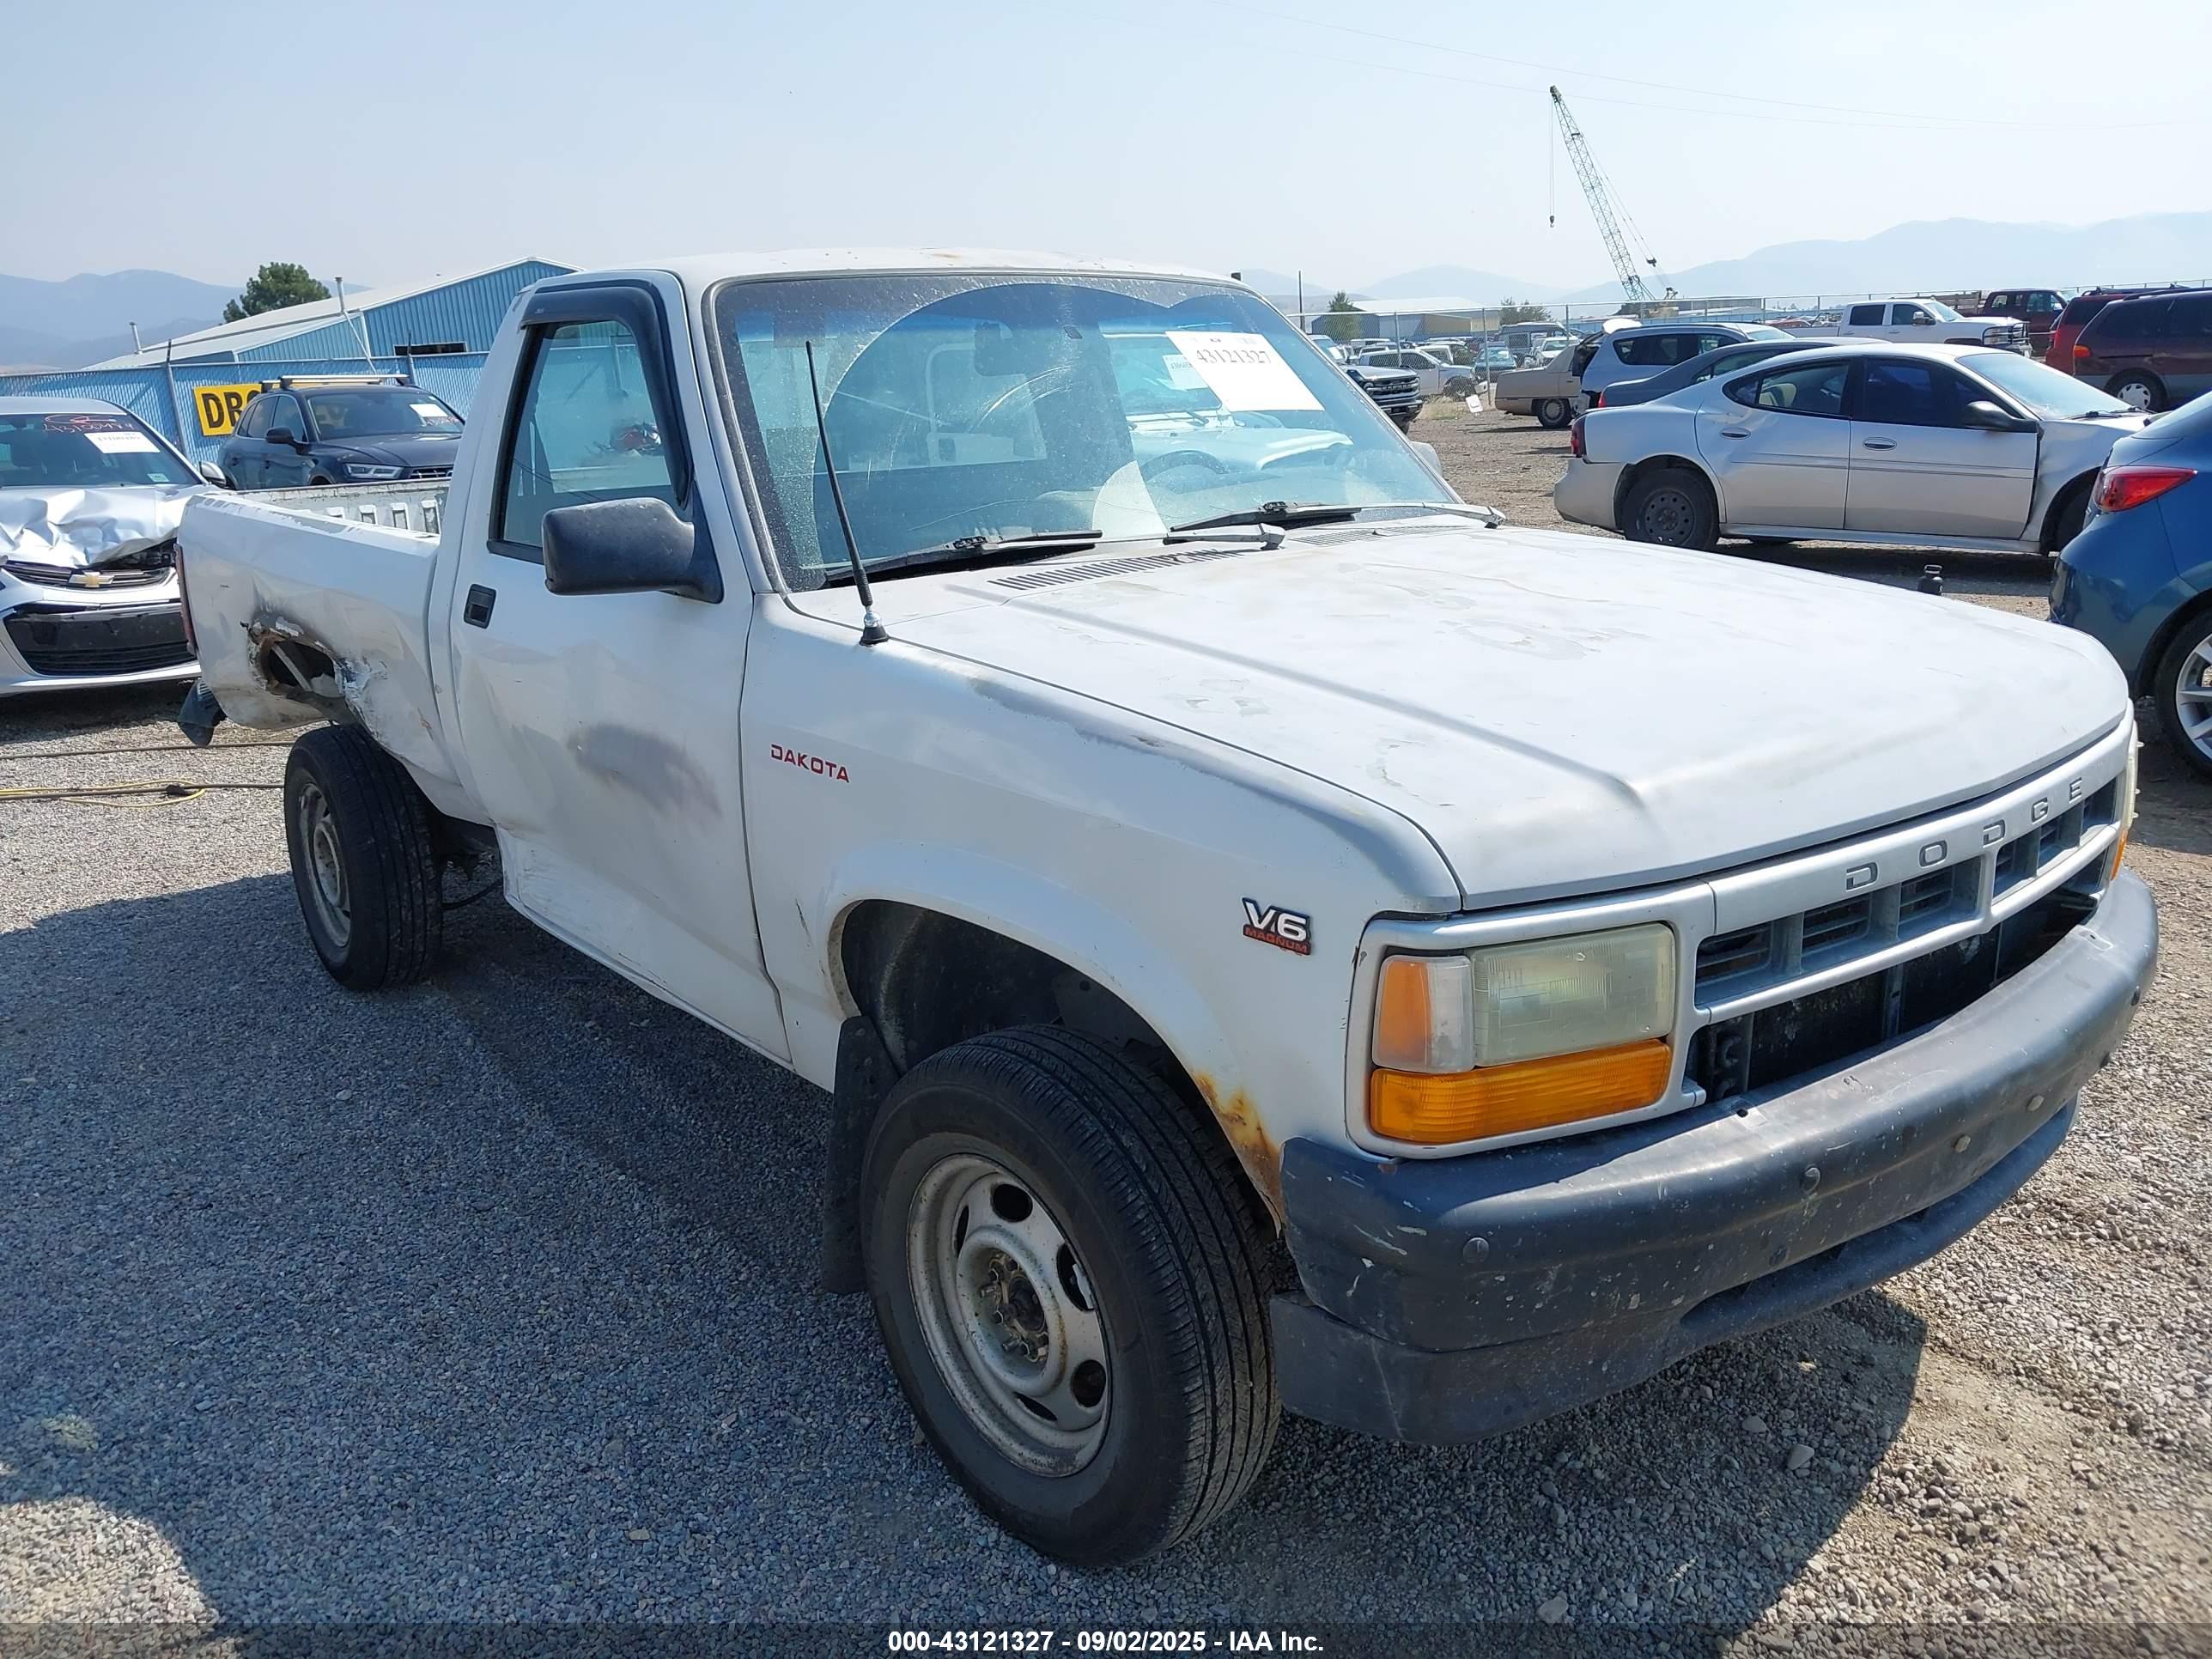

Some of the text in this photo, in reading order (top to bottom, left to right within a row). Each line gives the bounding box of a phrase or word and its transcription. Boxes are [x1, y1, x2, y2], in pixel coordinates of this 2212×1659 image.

[1196, 349, 1271, 364] 43121327
[771, 743, 850, 783] DAKOTA
[1846, 776, 2082, 892] DODGE
[1243, 898, 1309, 943] V6
[1243, 927, 1310, 953] MAGNUM
